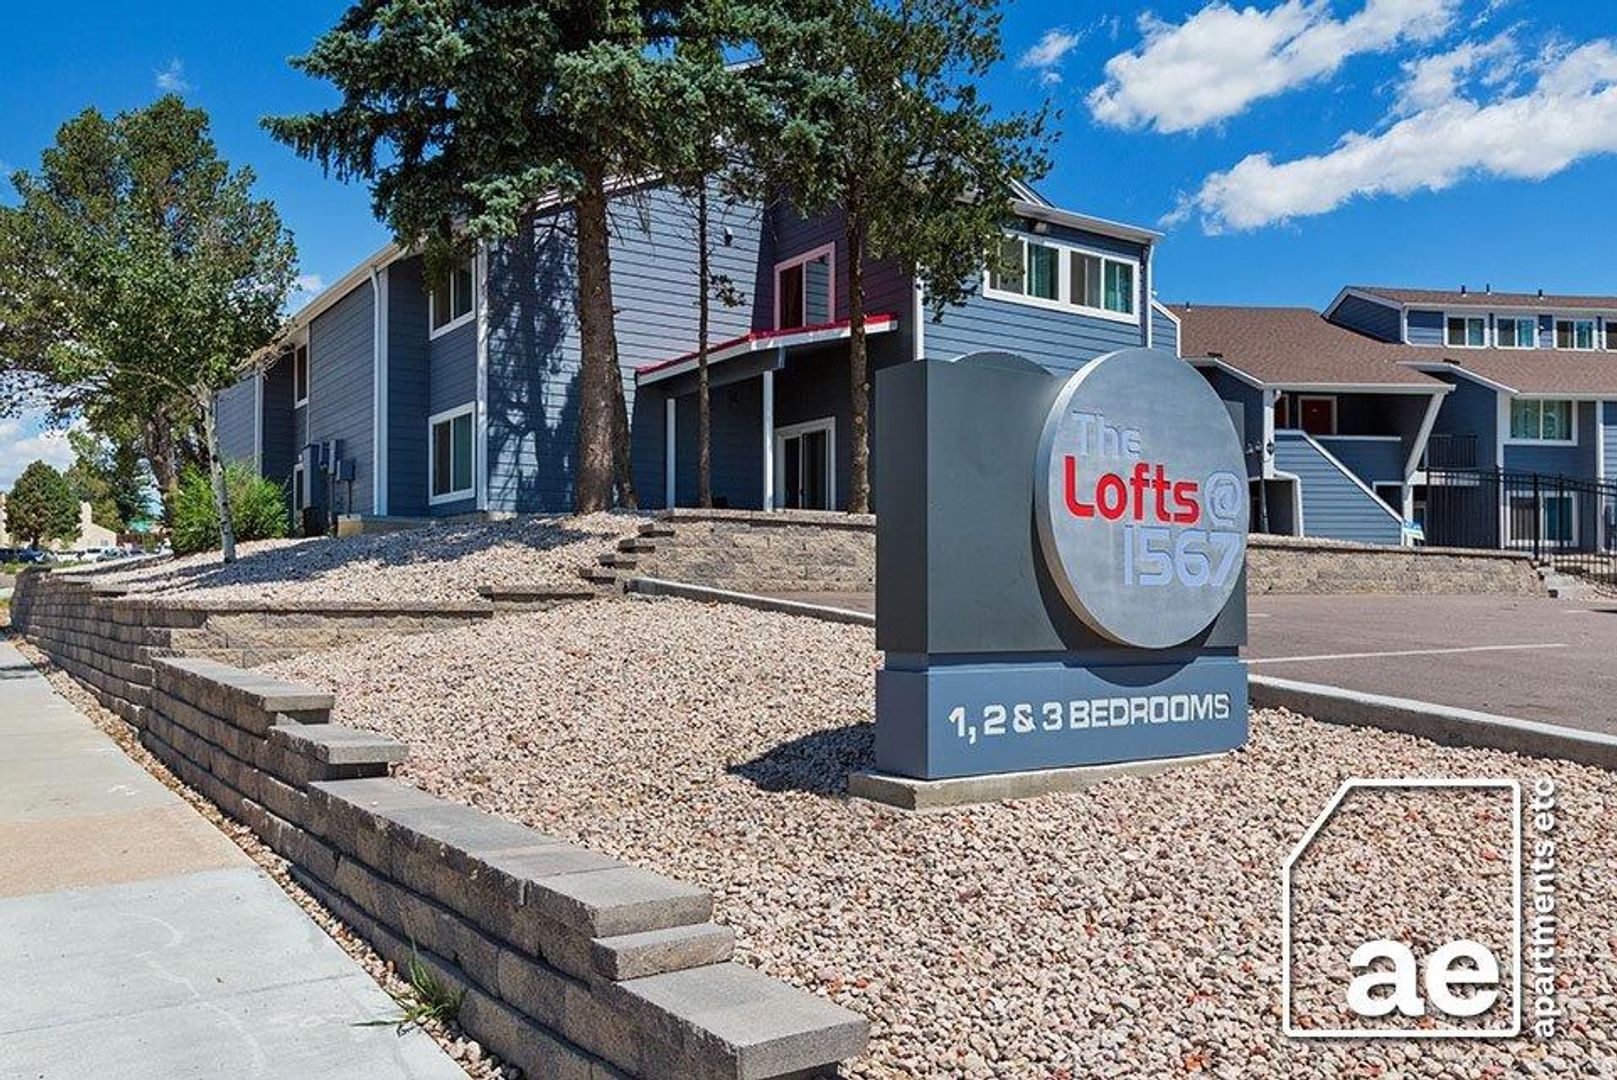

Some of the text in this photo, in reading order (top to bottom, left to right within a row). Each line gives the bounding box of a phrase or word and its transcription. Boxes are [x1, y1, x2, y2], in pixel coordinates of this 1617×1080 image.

[1072, 410, 1142, 459] The
[1124, 524, 1242, 588] 1567
[983, 704, 1007, 735] 2
[1012, 702, 1036, 733] &
[1042, 701, 1063, 731] 3
[1069, 693, 1231, 729] BEDROOMS
